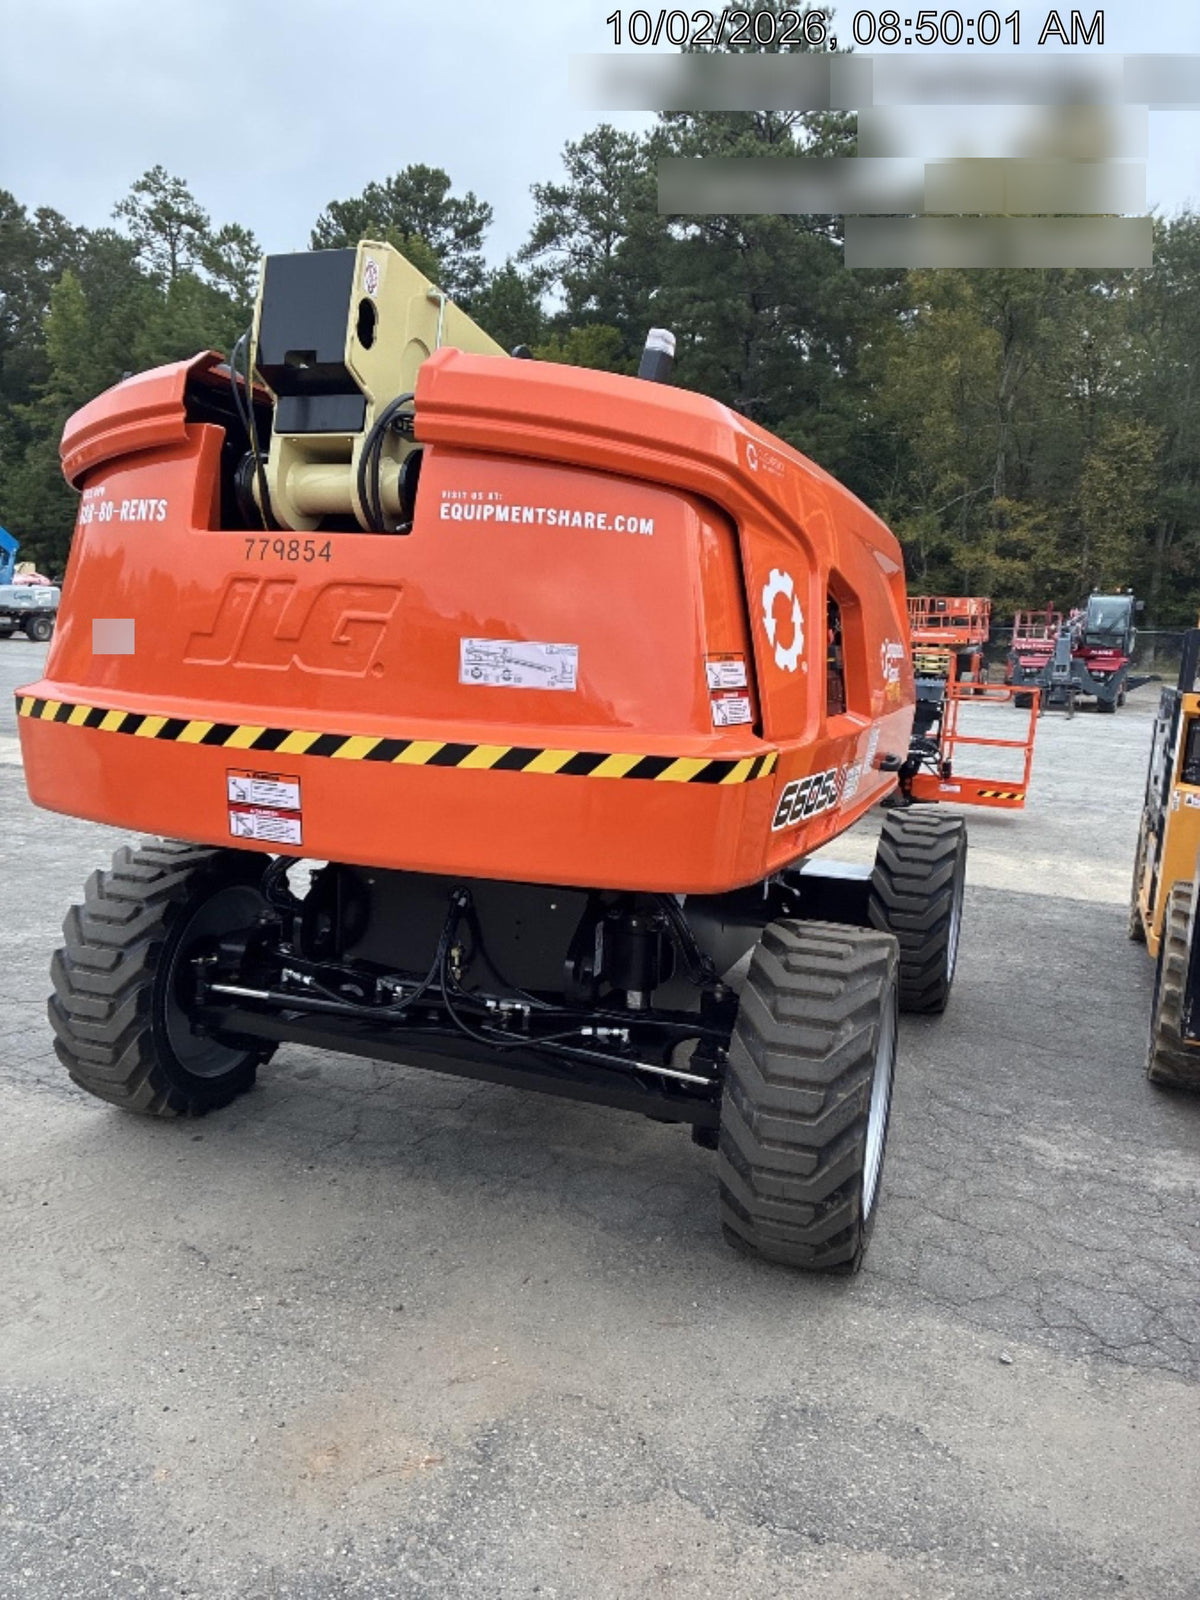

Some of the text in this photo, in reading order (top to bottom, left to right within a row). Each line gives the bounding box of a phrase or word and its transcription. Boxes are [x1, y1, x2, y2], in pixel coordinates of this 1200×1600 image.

[440, 502, 654, 535] EQUIPMENTSHARE.COM
[243, 538, 333, 563] 779854
[182, 573, 403, 678] JLG
